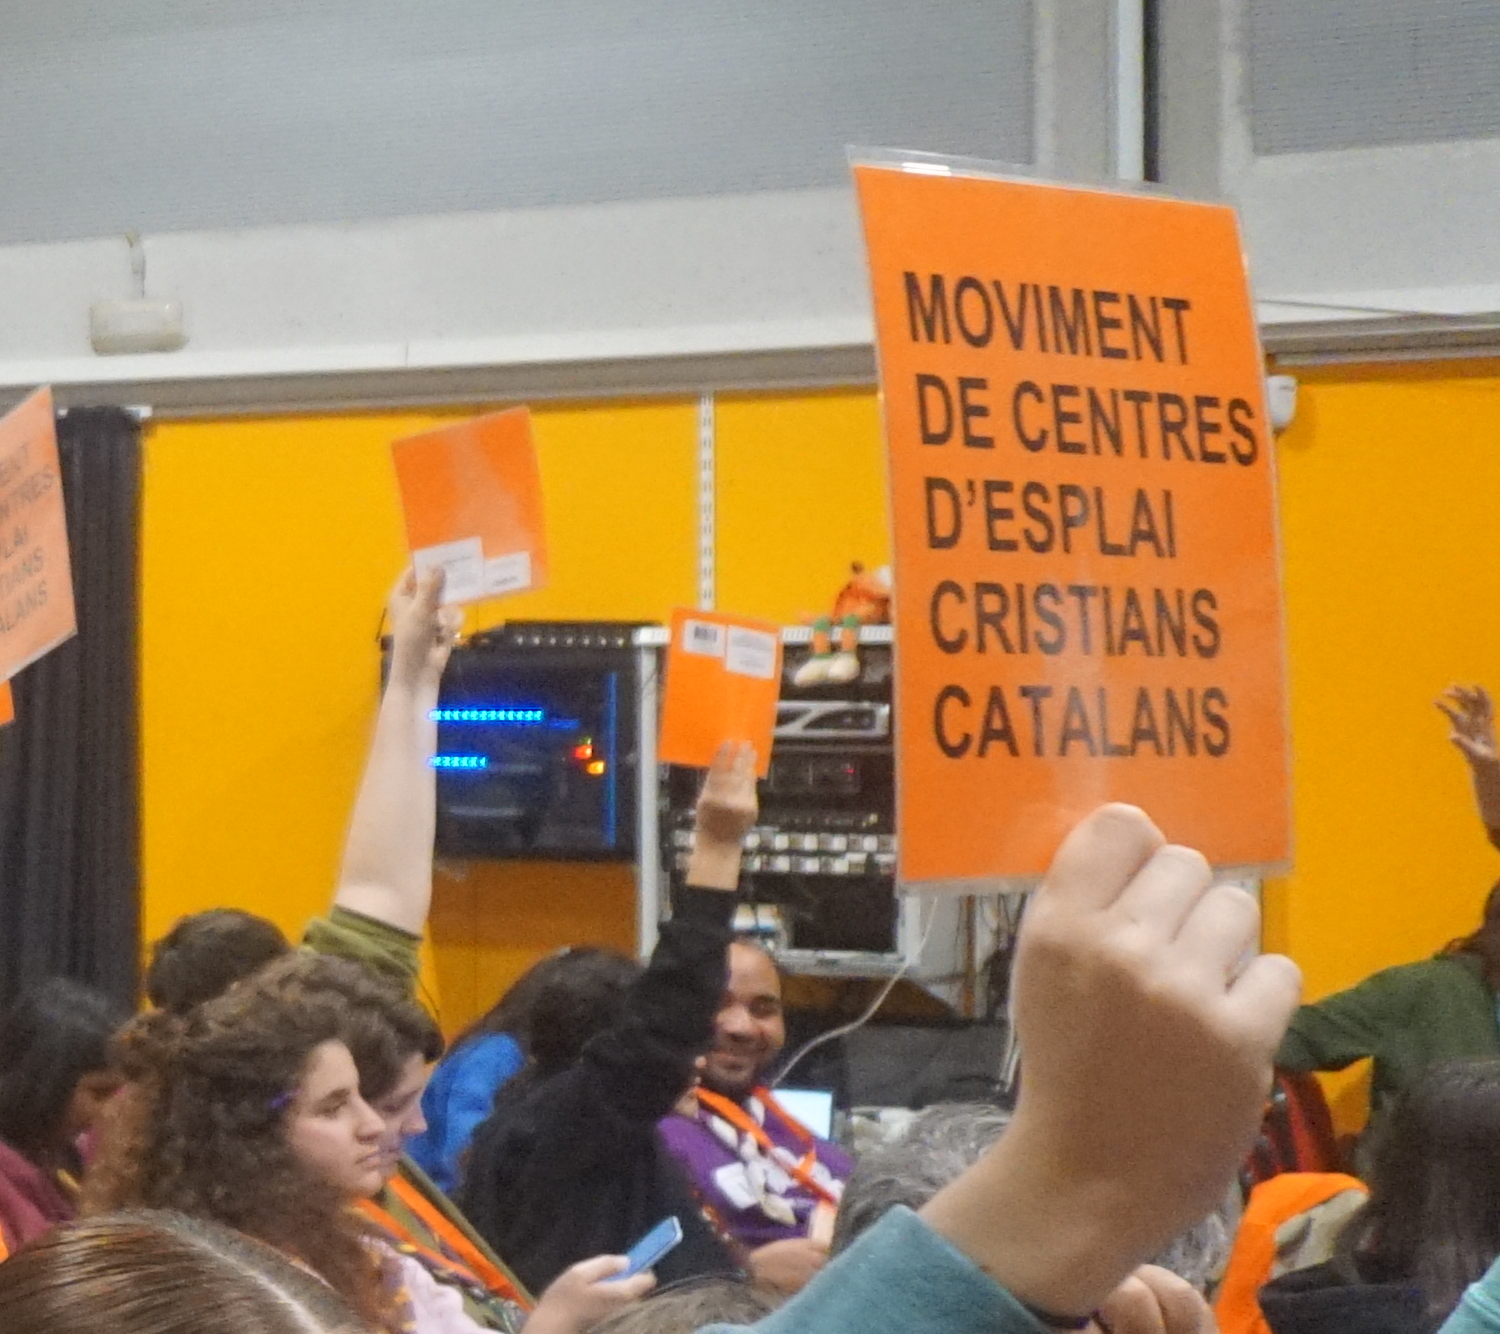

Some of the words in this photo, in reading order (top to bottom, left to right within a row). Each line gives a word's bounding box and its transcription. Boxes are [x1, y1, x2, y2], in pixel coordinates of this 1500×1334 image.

[903, 271, 1191, 366] MOVIMENT
[915, 373, 995, 449] DE
[1012, 380, 1258, 467] CENTRES
[930, 579, 1221, 659] CRISTIANS
[934, 684, 1231, 760] CATALANS
